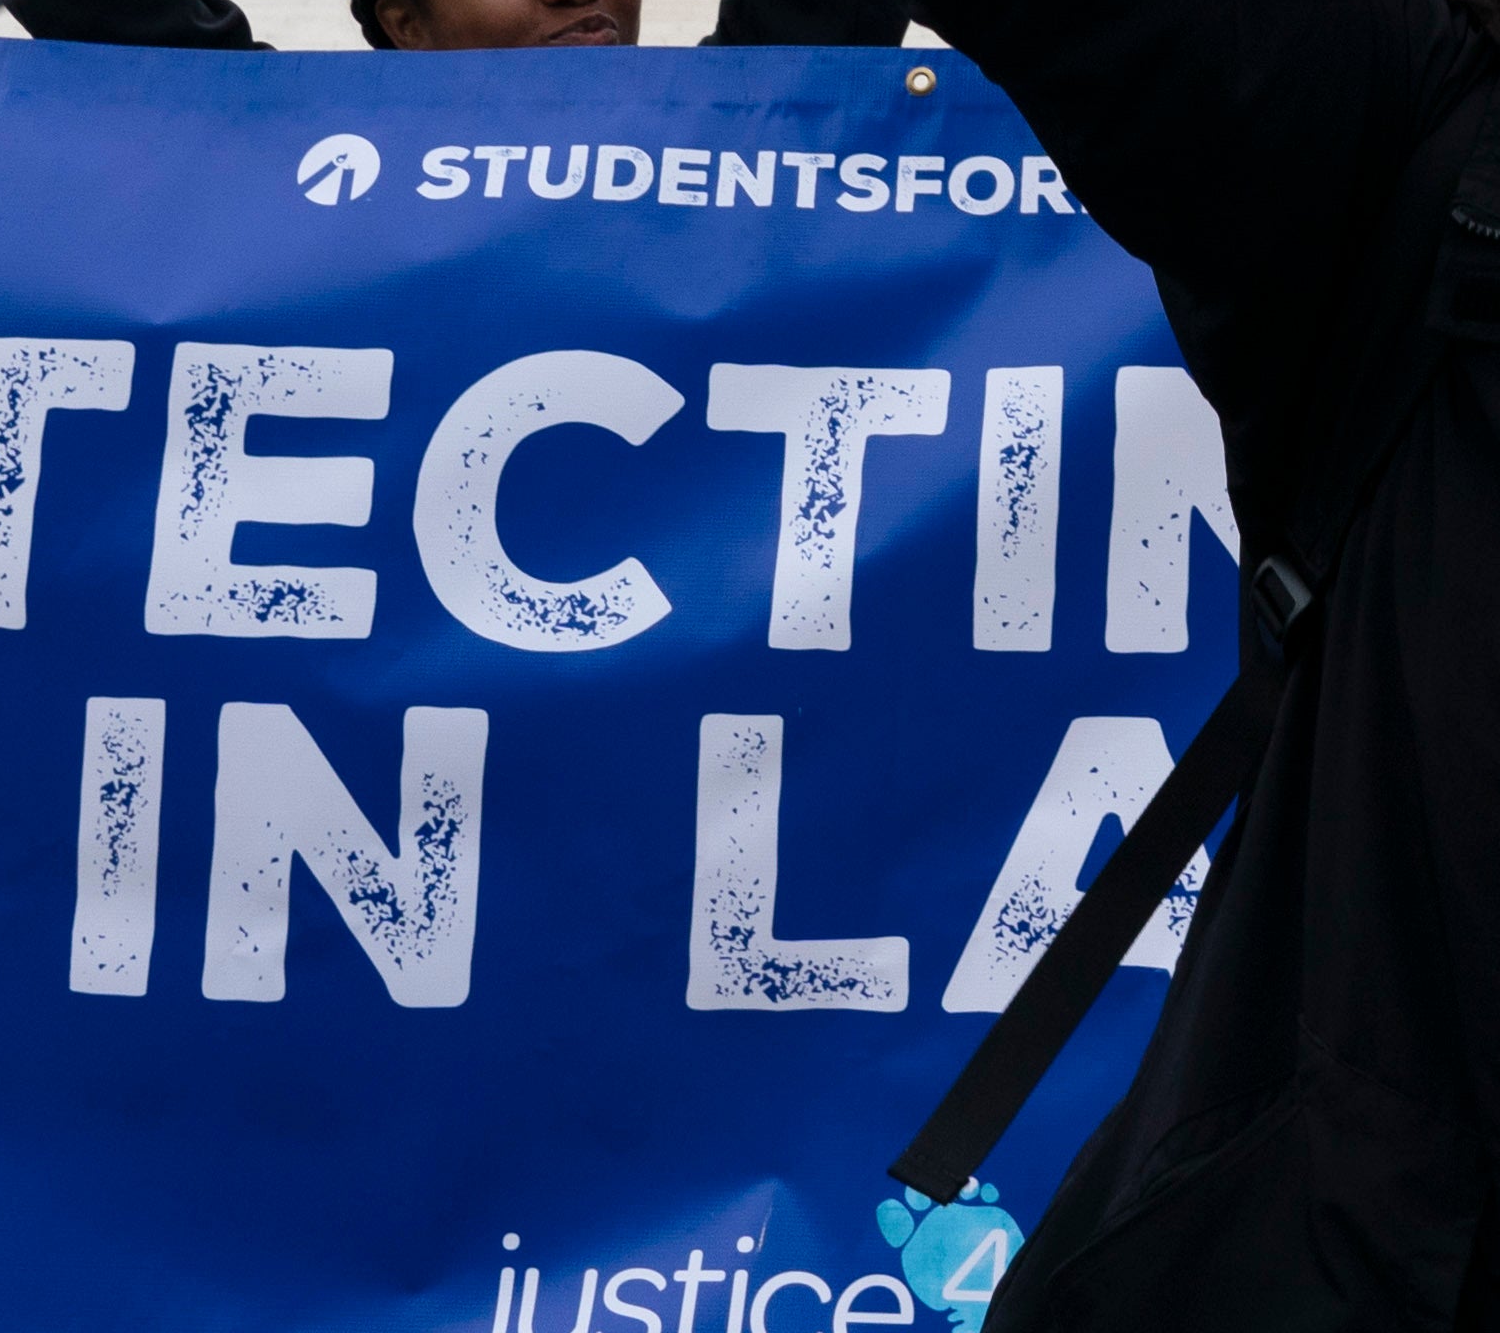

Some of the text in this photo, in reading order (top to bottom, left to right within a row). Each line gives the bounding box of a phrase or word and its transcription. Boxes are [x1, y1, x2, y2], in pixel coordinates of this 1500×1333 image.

[416, 145, 1088, 216] STUDENTSFOR
[69, 695, 1211, 1013] IN LA
